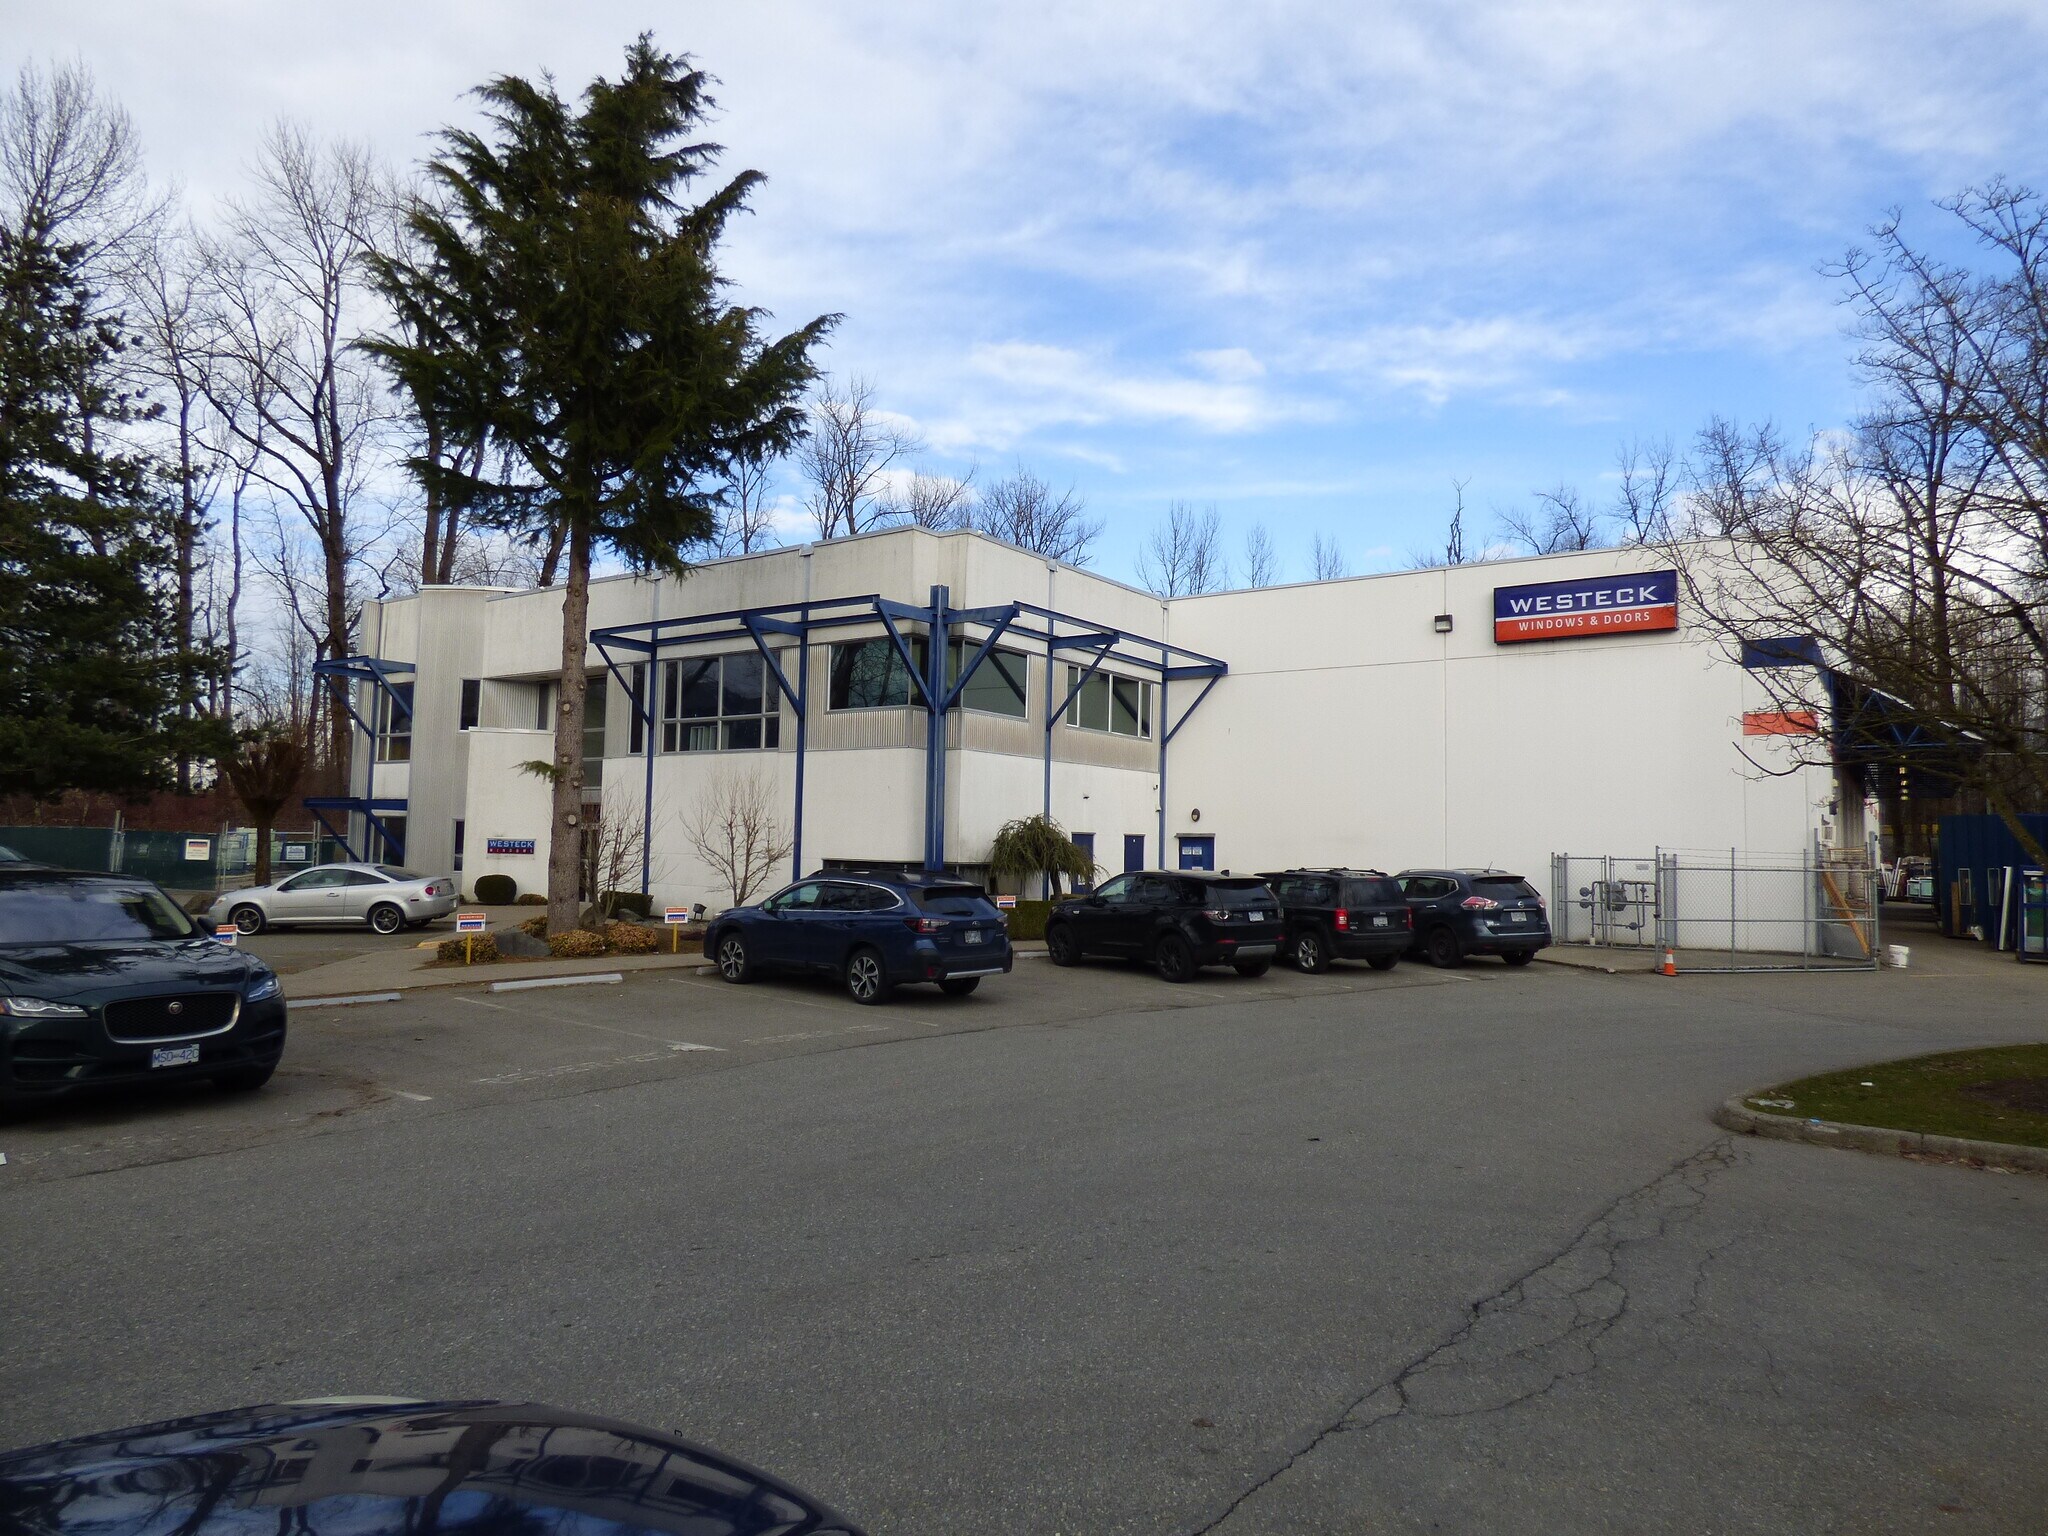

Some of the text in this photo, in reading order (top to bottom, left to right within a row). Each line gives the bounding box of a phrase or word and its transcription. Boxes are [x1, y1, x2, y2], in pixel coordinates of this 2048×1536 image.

[1510, 585, 1659, 614] WESTECK
[1518, 611, 1651, 632] WINDOWS & DOORS
[489, 840, 533, 848] WESTECK
